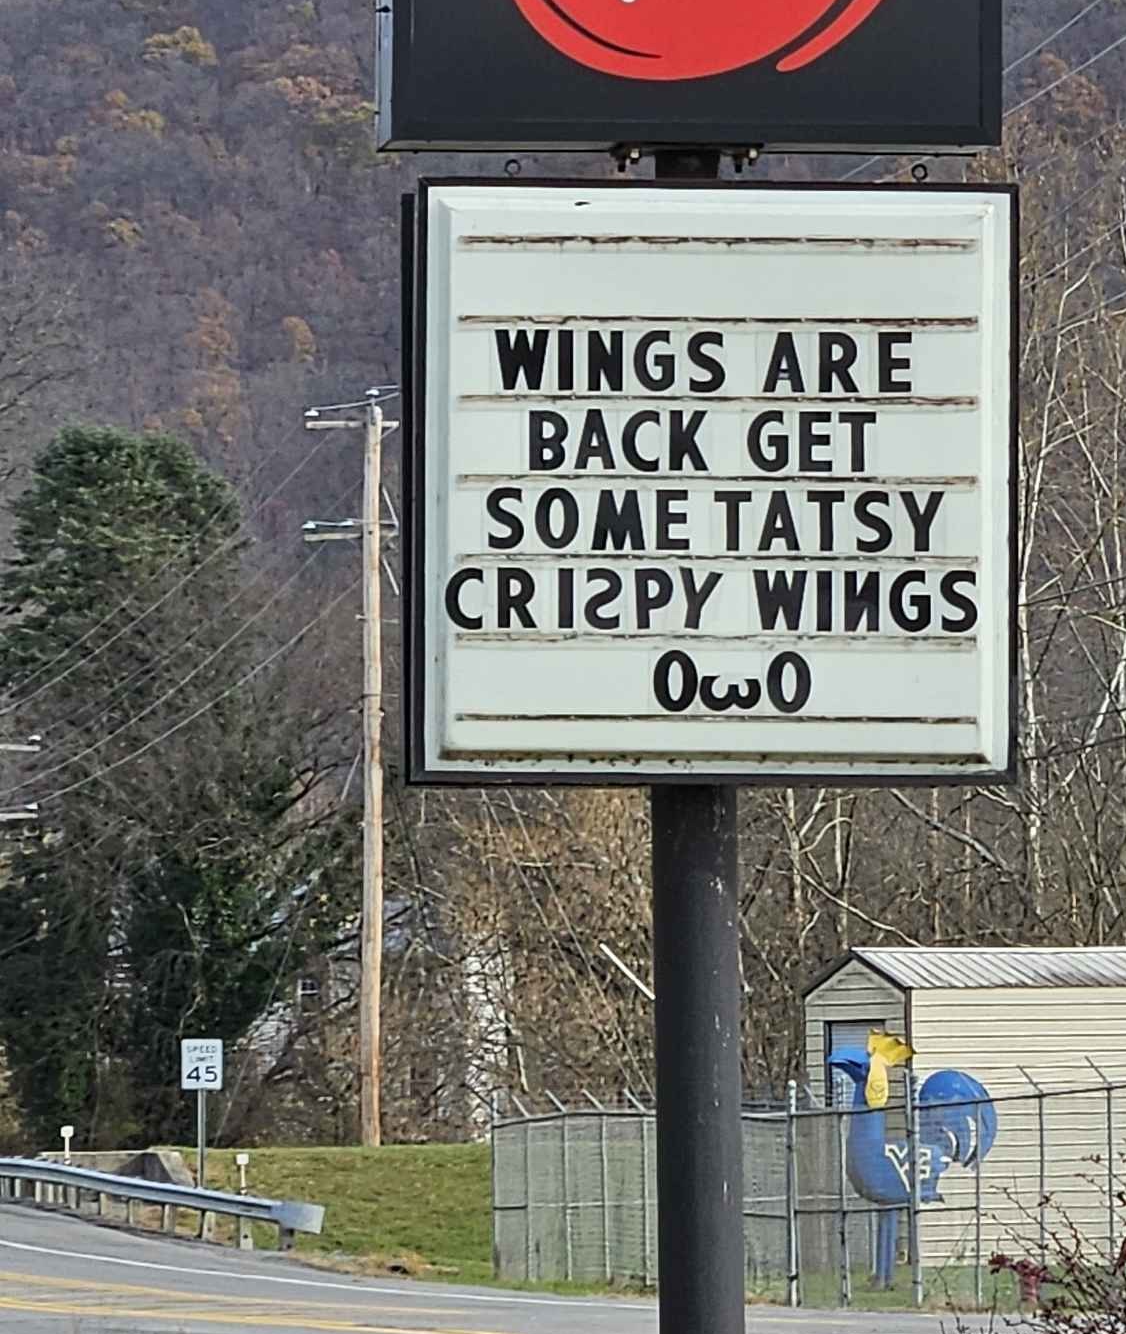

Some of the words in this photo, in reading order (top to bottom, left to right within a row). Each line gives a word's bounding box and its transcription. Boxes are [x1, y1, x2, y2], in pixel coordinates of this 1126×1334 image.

[494, 329, 726, 393] WINGS
[762, 331, 913, 393] ARE
[528, 409, 709, 473] BACK
[746, 410, 877, 473] GET
[486, 487, 690, 552] SOME
[713, 489, 945, 554] TATSY
[444, 567, 724, 631] CRISPY
[752, 569, 978, 633] WINGS
[185, 1065, 218, 1083] 45
